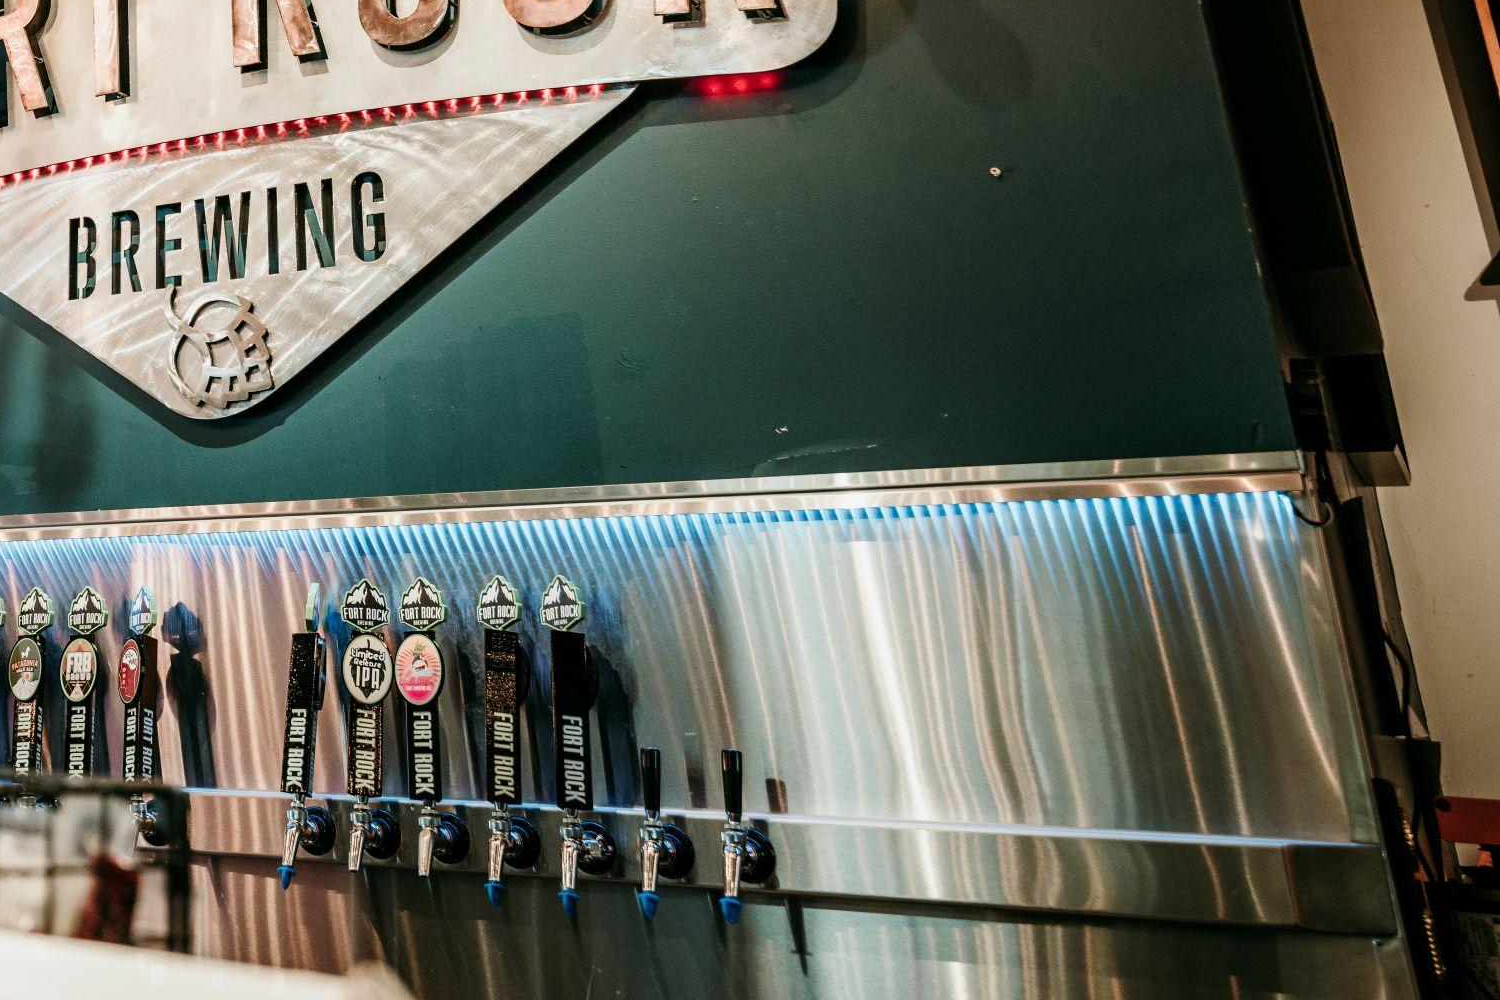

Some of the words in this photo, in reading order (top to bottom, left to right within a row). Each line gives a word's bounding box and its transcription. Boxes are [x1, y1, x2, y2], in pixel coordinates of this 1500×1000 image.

[68, 171, 386, 300] BREWING
[19, 613, 32, 625] FORT
[33, 613, 49, 624] ROCK
[70, 613, 84, 625] FORT
[86, 613, 102, 624] ROCK
[343, 607, 363, 619] FORT
[366, 607, 389, 621] ROCK
[400, 607, 419, 620] FORT
[421, 606, 442, 619] ROCK
[479, 606, 496, 620] FORT
[497, 605, 516, 618] ROCK
[541, 606, 558, 622] FORT
[560, 605, 579, 618] ROCK
[66, 652, 92, 673] FRB
[351, 648, 386, 661] Limited
[353, 657, 381, 668] Release
[355, 667, 380, 690] IPA
[17, 705, 32, 739] FORT
[70, 705, 86, 740] FORT
[126, 707, 137, 742] FORT
[143, 707, 154, 744] FORT
[289, 708, 307, 745] FORT
[356, 708, 376, 750] FORT
[413, 711, 433, 749] FORT
[493, 711, 514, 752] FORT
[562, 715, 584, 757] FORT
[68, 743, 84, 782] ROCK
[125, 745, 136, 783] ROCK
[142, 746, 153, 784] ROCK
[286, 748, 304, 791] ROCK
[354, 749, 375, 794] ROCK
[414, 753, 435, 795] ROCK
[494, 755, 515, 799] ROCK
[564, 759, 587, 804] ROCK
